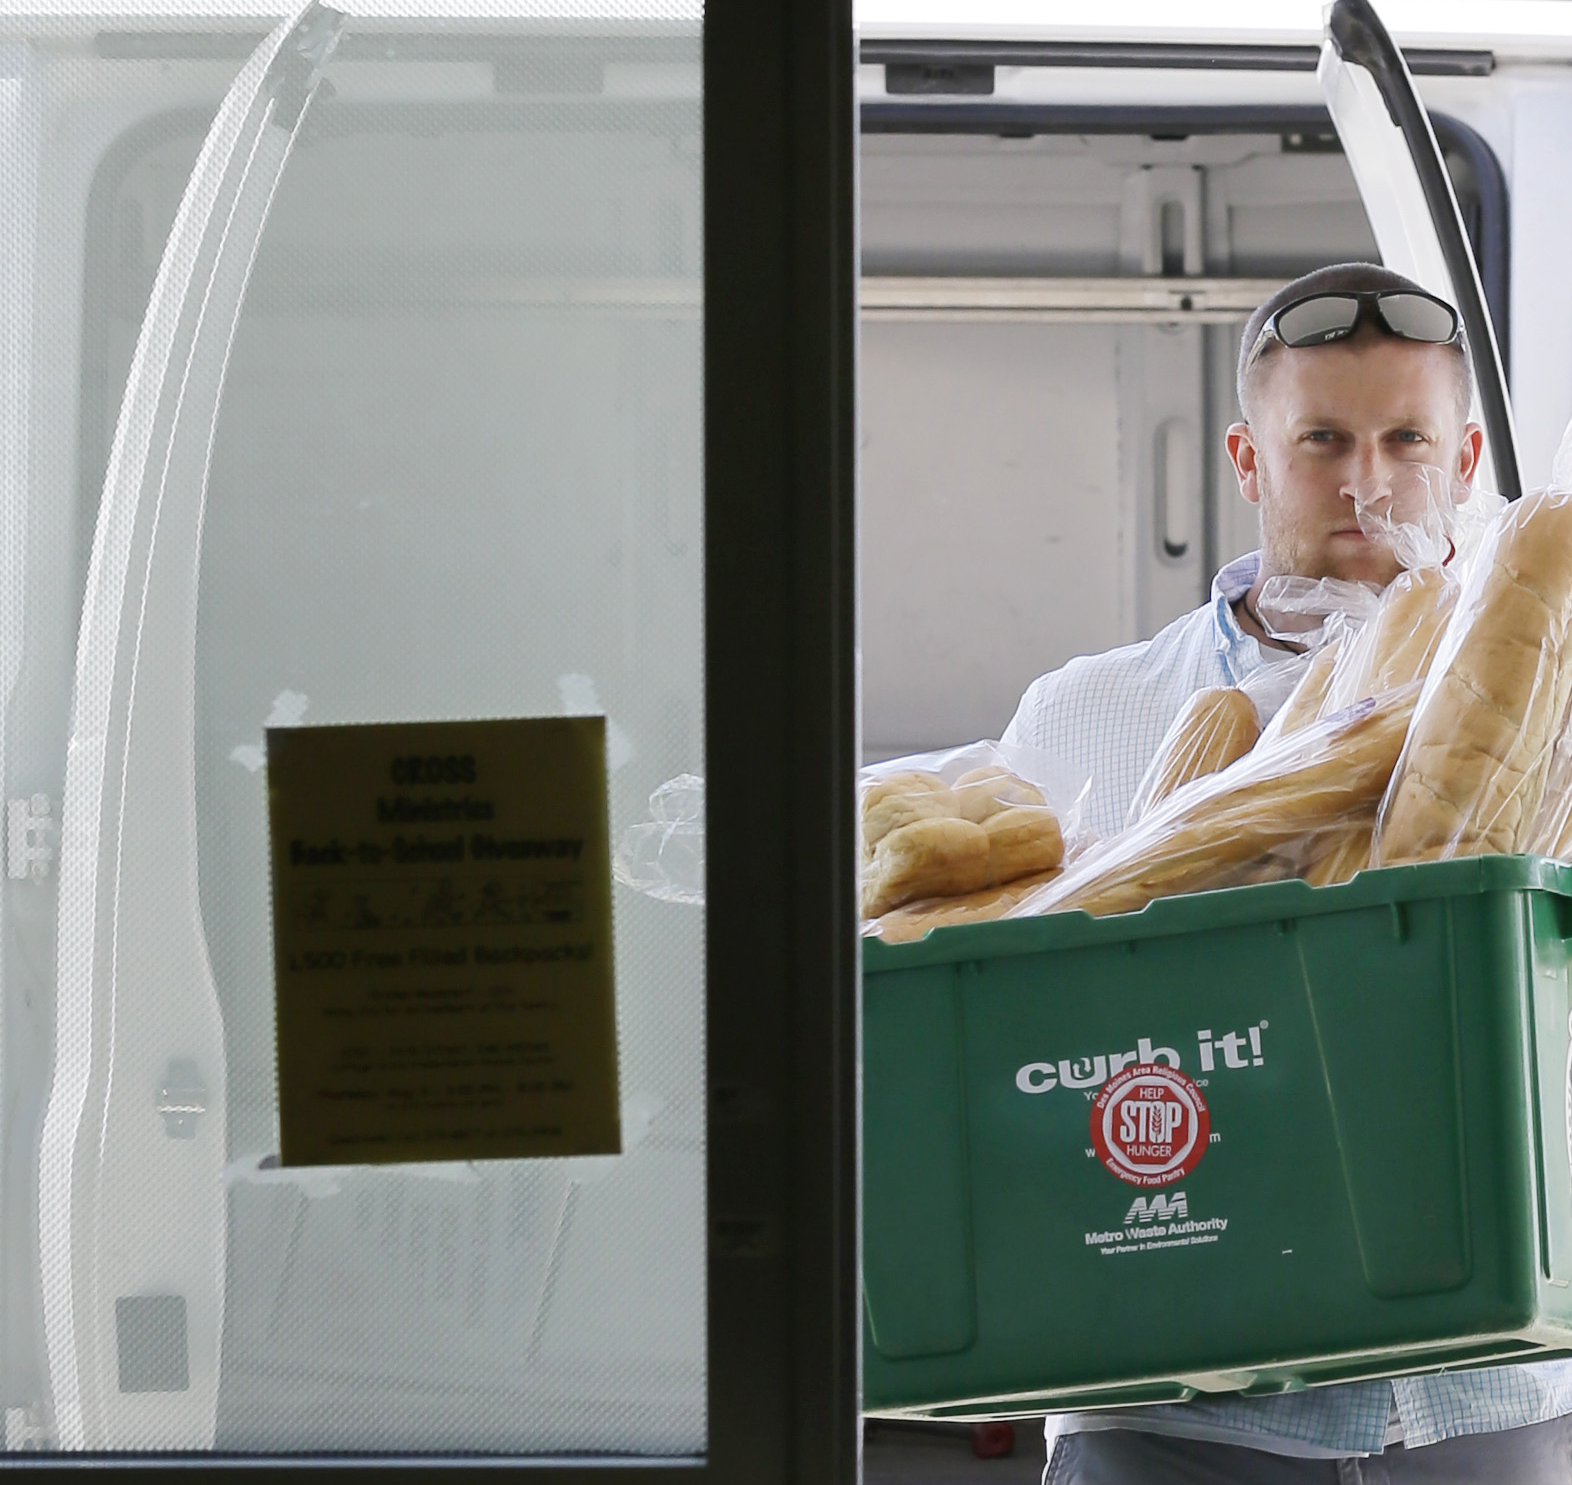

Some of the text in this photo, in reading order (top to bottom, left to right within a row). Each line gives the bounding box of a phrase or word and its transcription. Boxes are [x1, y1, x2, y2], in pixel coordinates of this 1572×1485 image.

[1015, 1038, 1181, 1094] curb
[1106, 1071, 1132, 1094] Moines
[1132, 1066, 1151, 1077] Area
[1152, 1066, 1187, 1086] Religious
[1186, 1083, 1206, 1113] Council
[1139, 1087, 1165, 1099] HELP
[1120, 1100, 1183, 1143] STOP
[1126, 1145, 1172, 1157] HUNGER
[1105, 1158, 1186, 1185] Emergency Food Pantry
[1085, 1217, 1228, 1245] Metro Waste Authority
